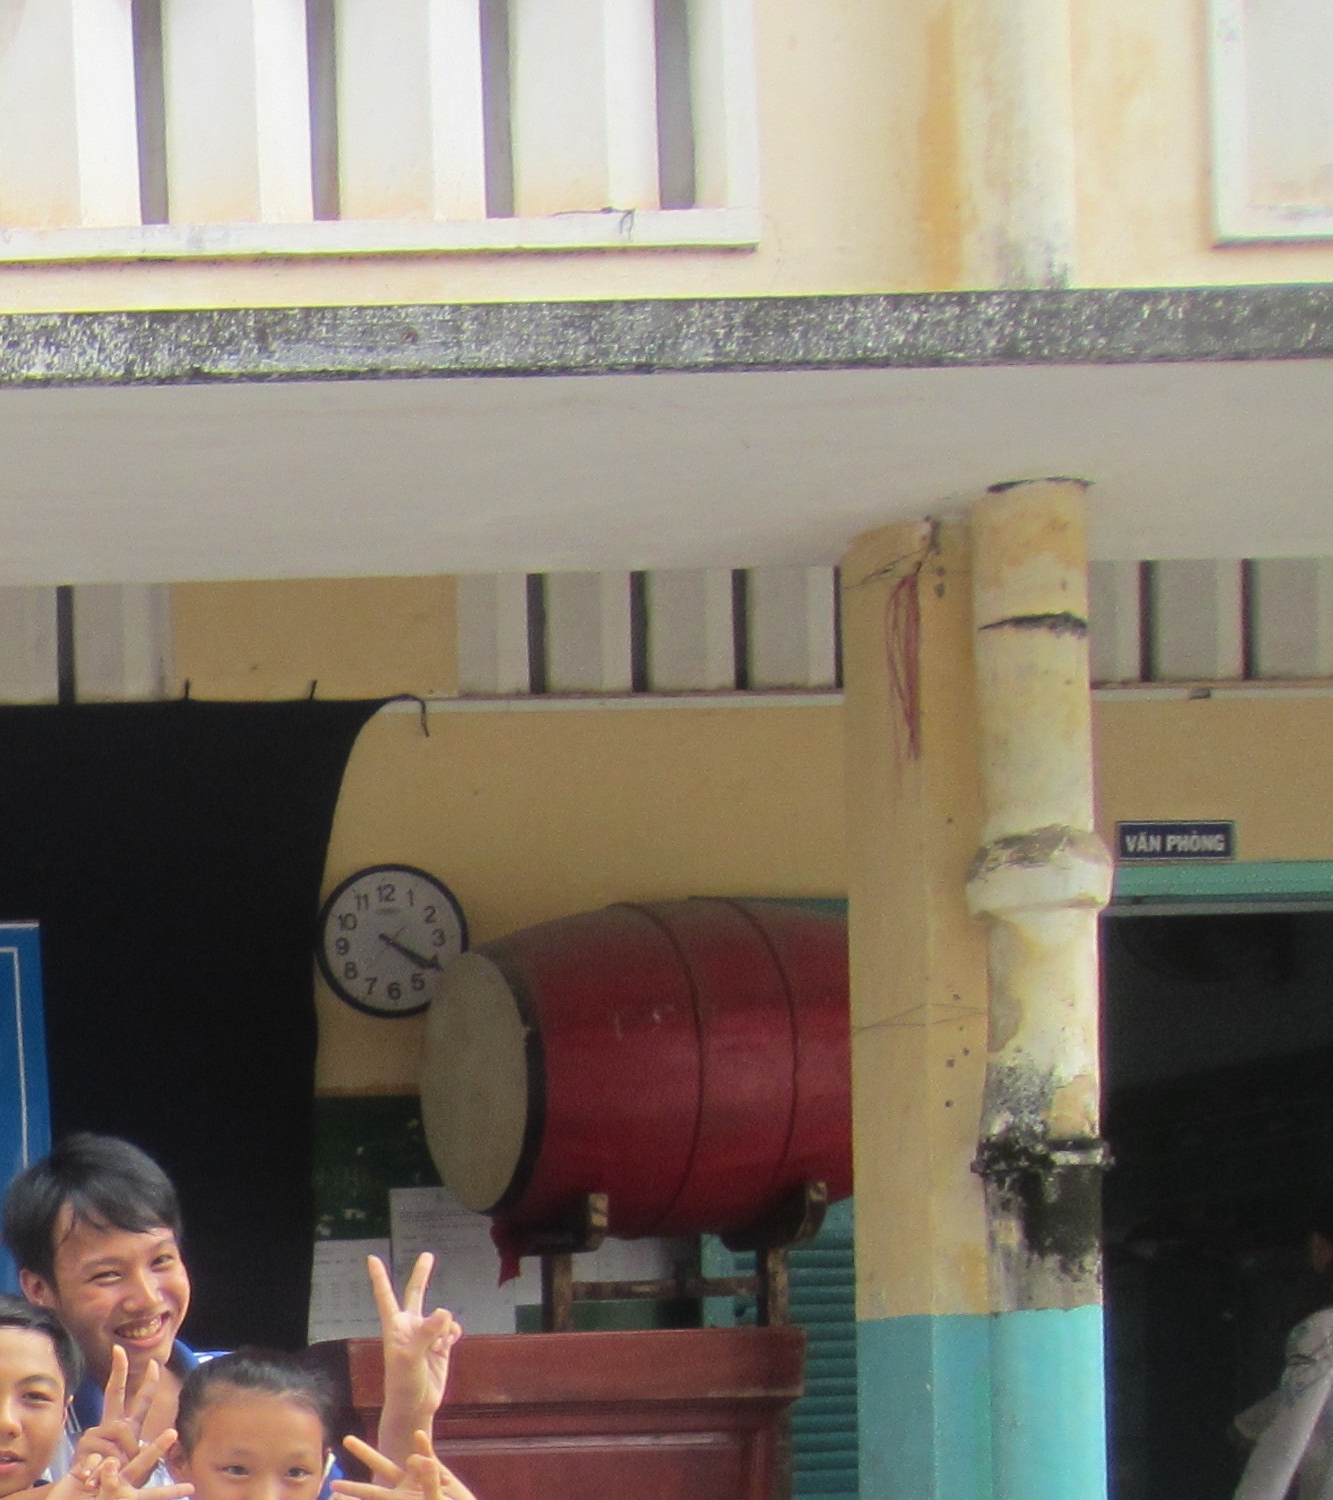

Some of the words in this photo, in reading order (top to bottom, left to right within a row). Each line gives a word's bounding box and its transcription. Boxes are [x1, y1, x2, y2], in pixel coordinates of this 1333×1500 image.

[355, 894, 369, 910] 11
[376, 884, 396, 902] 12
[407, 889, 414, 906] 1
[337, 913, 357, 930] 10
[424, 906, 436, 924] 2
[336, 938, 349, 955] 9
[433, 929, 445, 947] 3
[345, 961, 358, 979] 8
[366, 977, 378, 995] 7
[387, 982, 401, 1000] 6
[411, 973, 425, 991] 5
